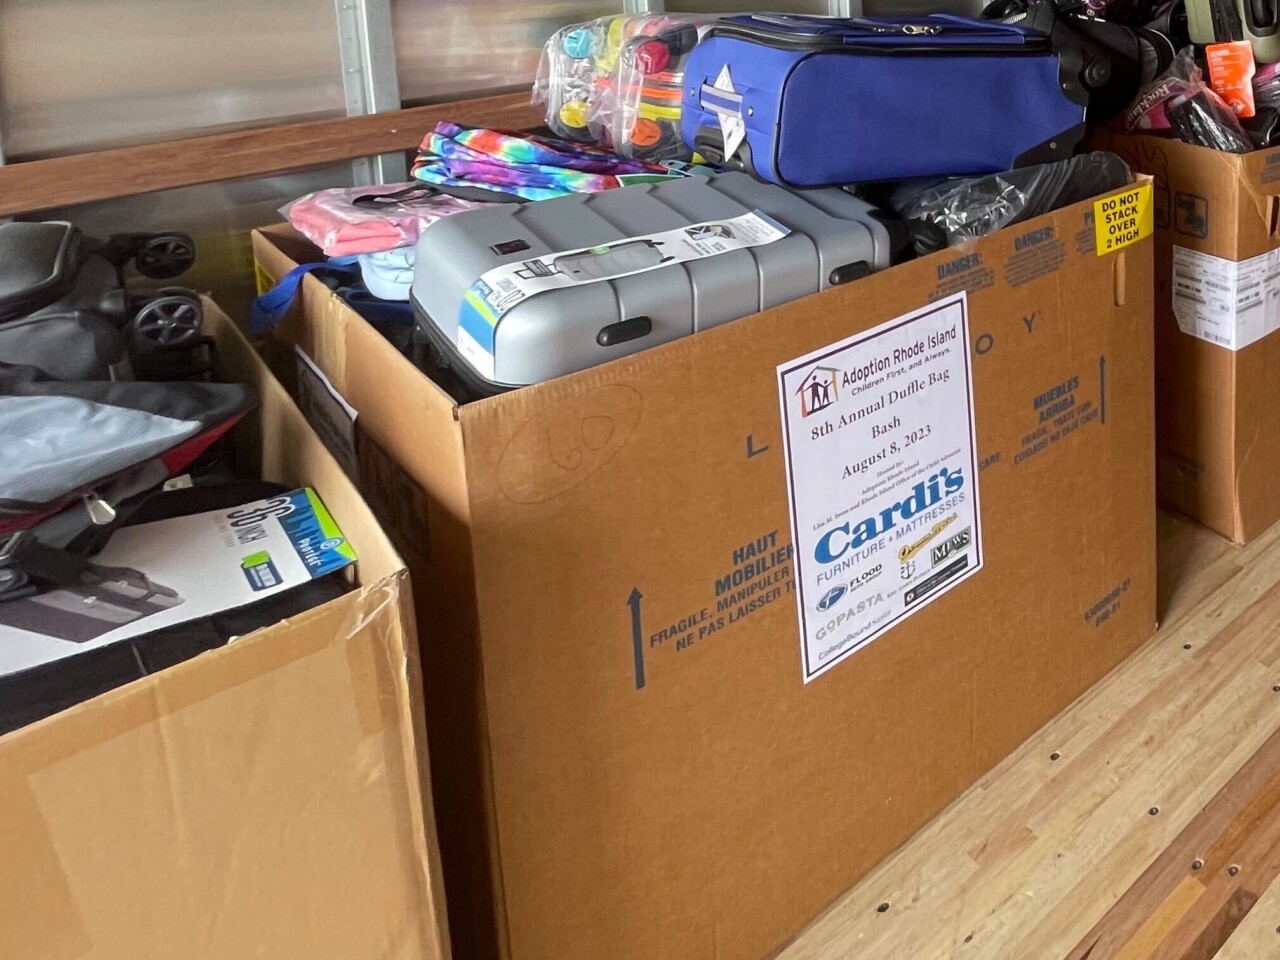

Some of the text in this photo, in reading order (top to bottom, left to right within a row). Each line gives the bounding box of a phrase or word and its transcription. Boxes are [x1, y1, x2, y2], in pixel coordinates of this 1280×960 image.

[1102, 192, 1140, 213] DO NOT
[1105, 205, 1138, 224] STACK
[1107, 239, 1113, 249] 2
[1115, 229, 1140, 246] HIGH
[1109, 218, 1136, 235] OVER
[842, 324, 956, 388] Adoption Rhode Island
[851, 348, 952, 396] Children First, and Always.
[811, 368, 950, 440] 8th Annual Duffle Bag
[1033, 376, 1079, 411] MUEBLES
[1039, 395, 1076, 425] ARRIBA
[871, 415, 901, 439] Bash
[842, 425, 931, 480] August 8, 2023
[814, 467, 964, 564] Cardi's
[733, 530, 777, 566] HAUT
[816, 538, 886, 585] FURNITURE
[896, 492, 965, 537] MATTRESSES
[717, 566, 789, 613] MANIPULER
[850, 564, 882, 587] FLOOD
[676, 632, 694, 652] NE
[700, 617, 725, 640] PAS
[729, 585, 781, 623] LAISSER
